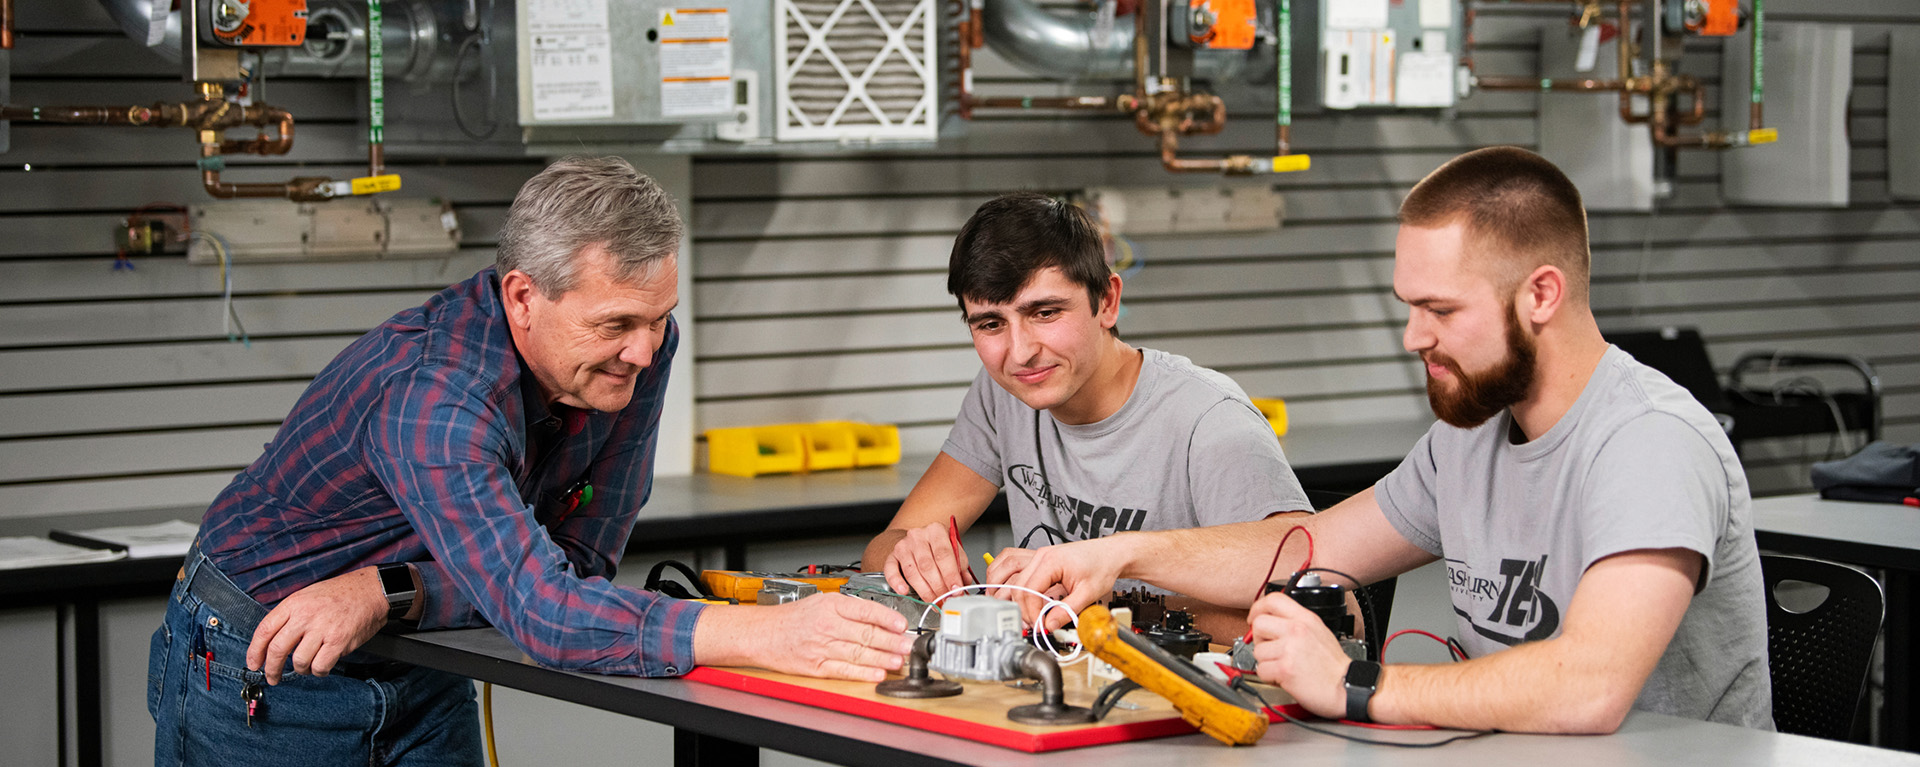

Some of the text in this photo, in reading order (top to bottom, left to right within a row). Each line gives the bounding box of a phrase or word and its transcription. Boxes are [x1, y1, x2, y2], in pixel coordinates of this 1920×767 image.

[369, 9, 383, 127] HOT WATER SUPPLY
